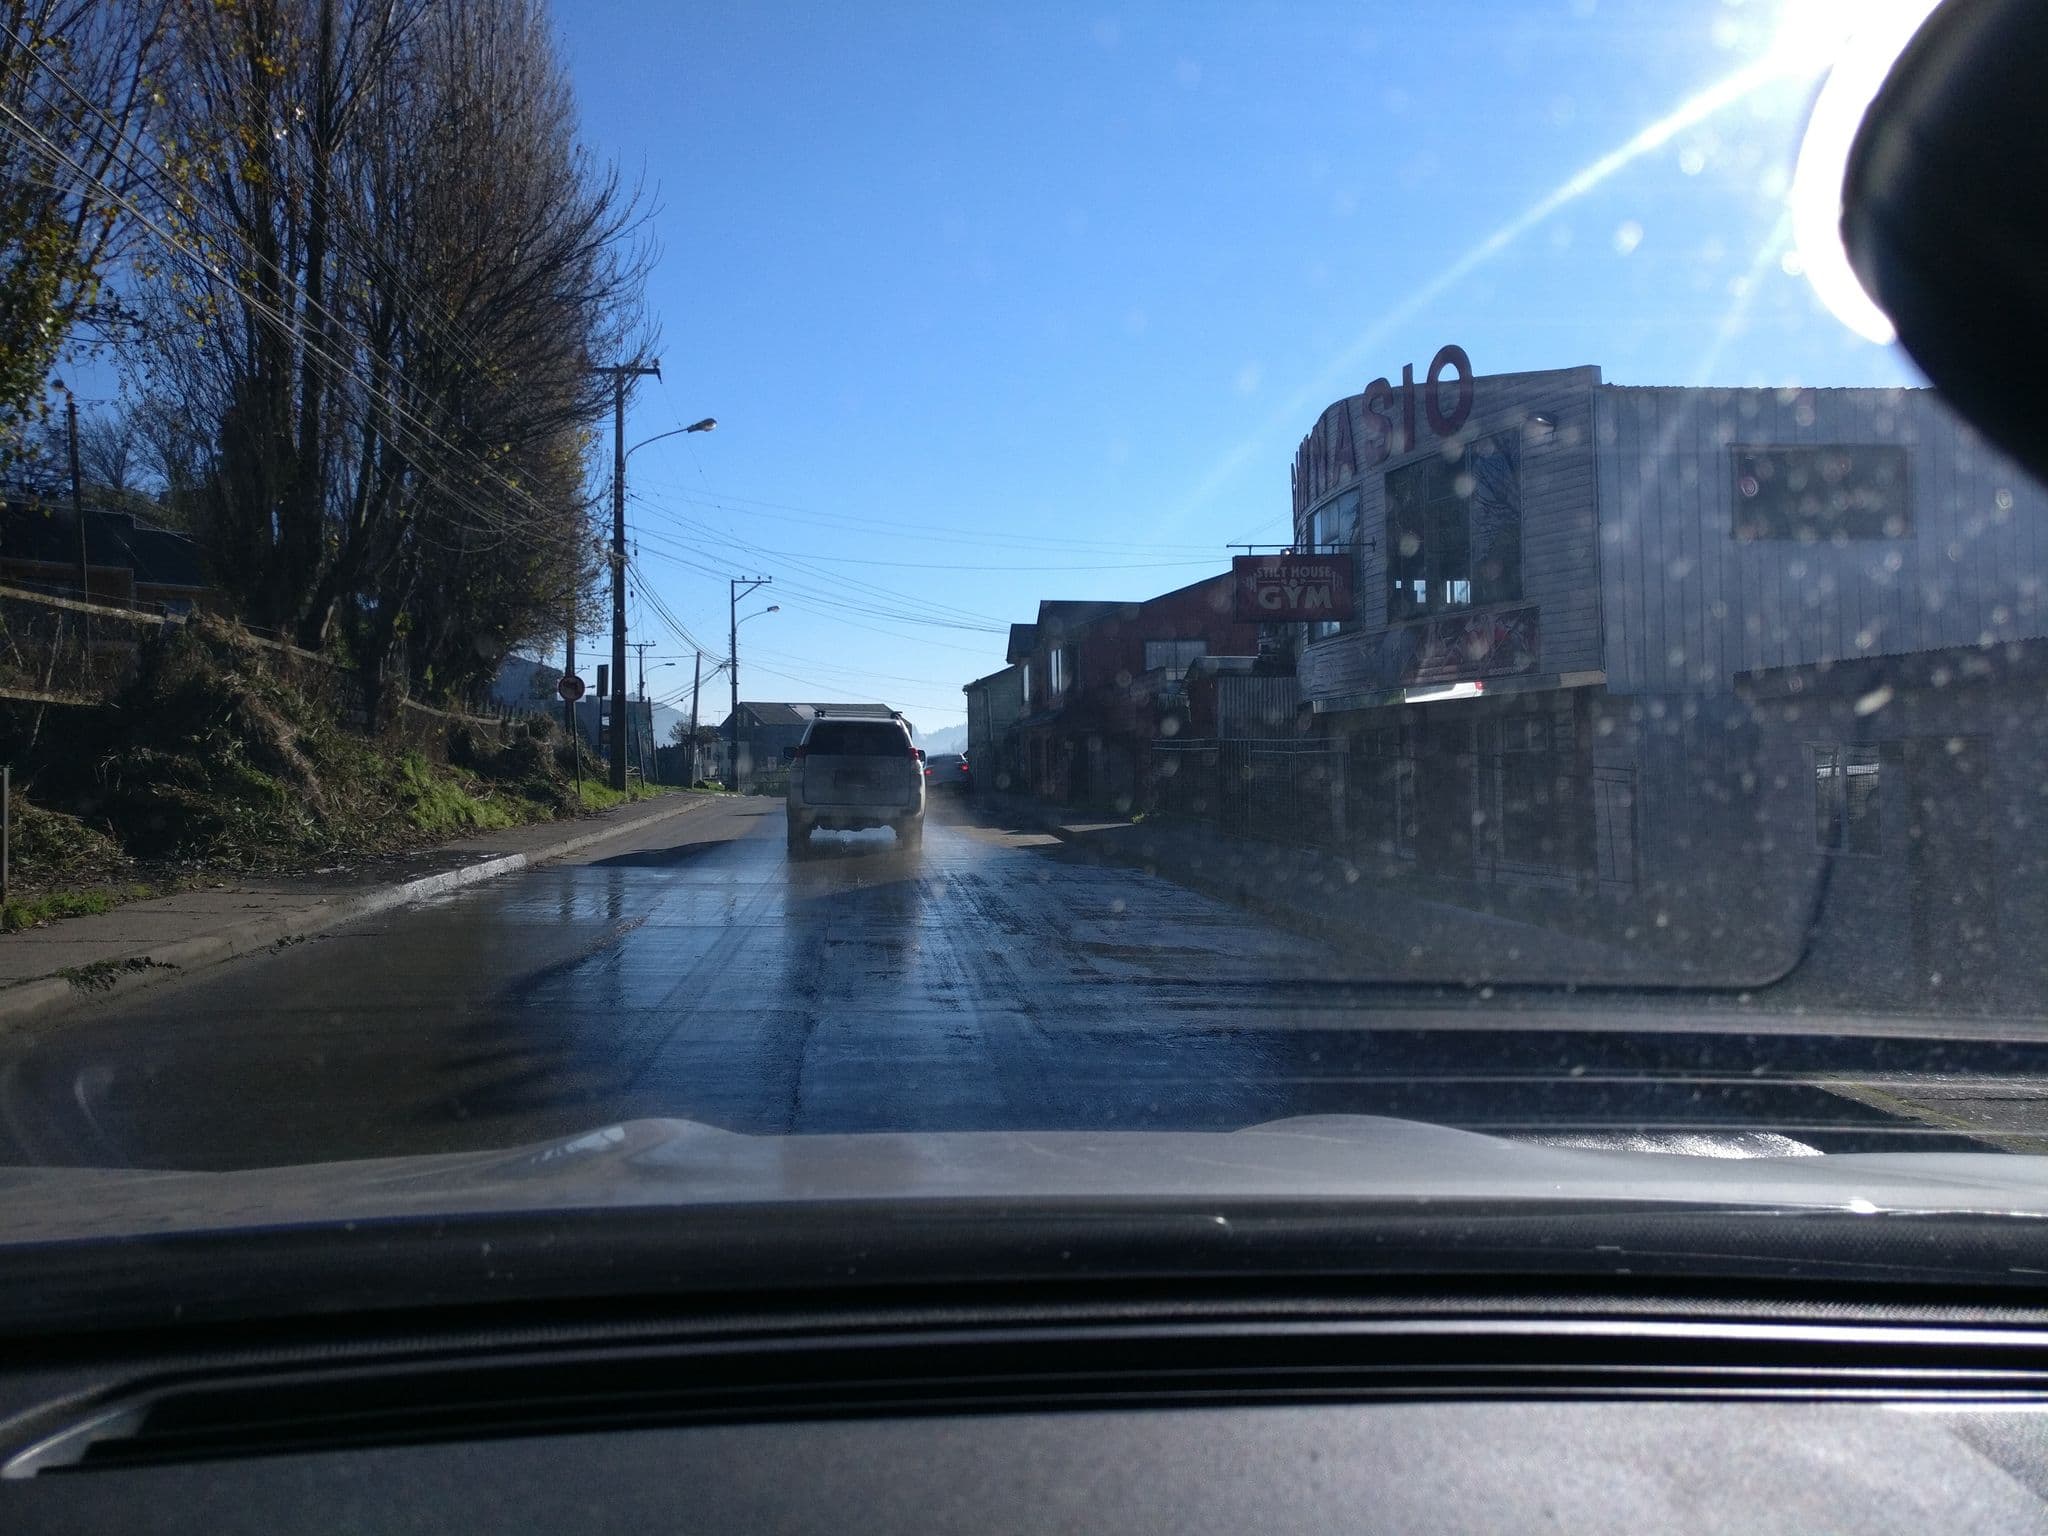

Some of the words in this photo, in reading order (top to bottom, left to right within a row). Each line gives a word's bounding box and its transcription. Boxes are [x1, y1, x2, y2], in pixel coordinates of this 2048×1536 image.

[1257, 566, 1287, 578] STILT
[1292, 565, 1332, 578] HOUSE
[1258, 585, 1333, 610] GYM
